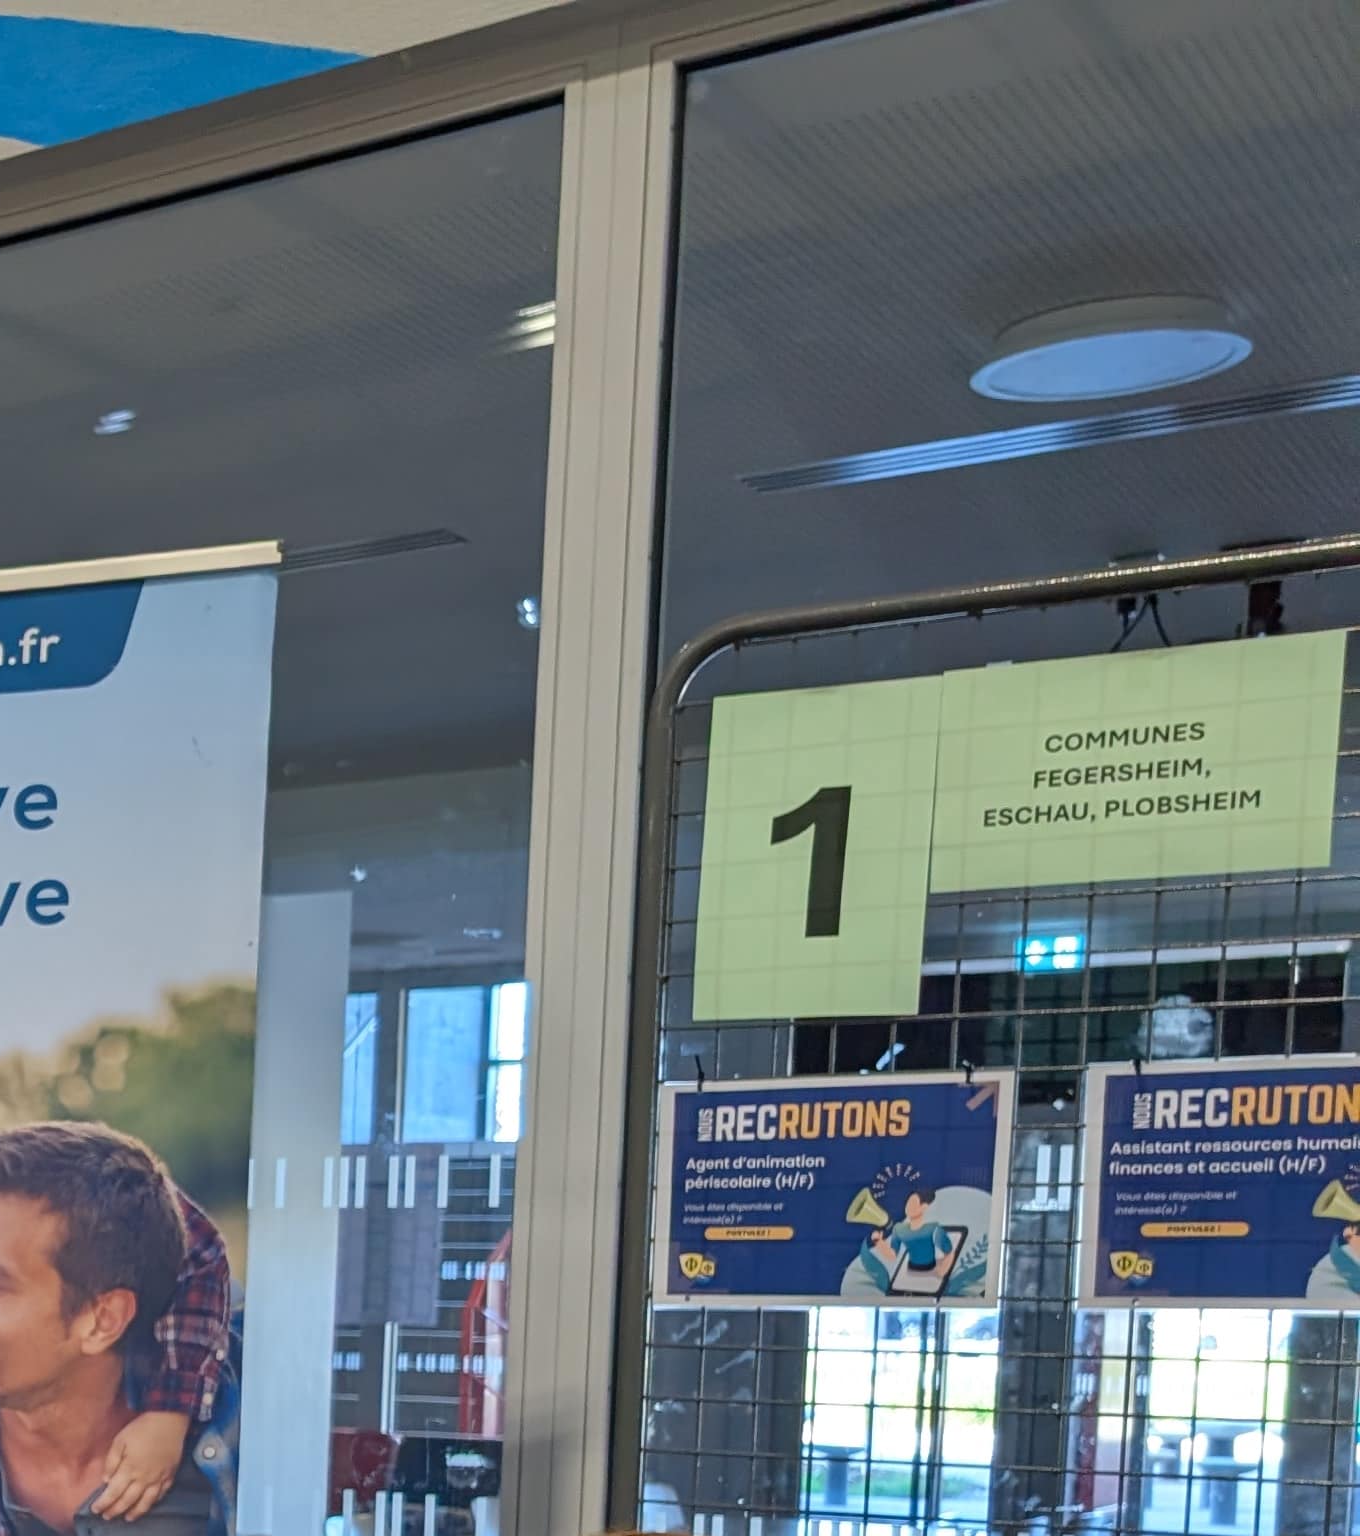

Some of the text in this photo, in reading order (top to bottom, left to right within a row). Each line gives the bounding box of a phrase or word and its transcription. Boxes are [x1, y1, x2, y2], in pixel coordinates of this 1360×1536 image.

[1045, 721, 1206, 754] COMMUNES
[1033, 757, 1212, 789] FEGERSHEIM,
[982, 789, 1262, 828] ESCHAU, PLOBSHEIM
[770, 785, 853, 939] 1
[715, 1099, 912, 1143] RECRUTONS
[1153, 1083, 1360, 1130] RECRUTON
[1110, 1135, 1360, 1156] Assistant ressources humai
[685, 1153, 826, 1174] Agent d'animation
[1109, 1154, 1326, 1176] finances et accueil (H/F)
[684, 1172, 815, 1193] périscolaire (H/F)
